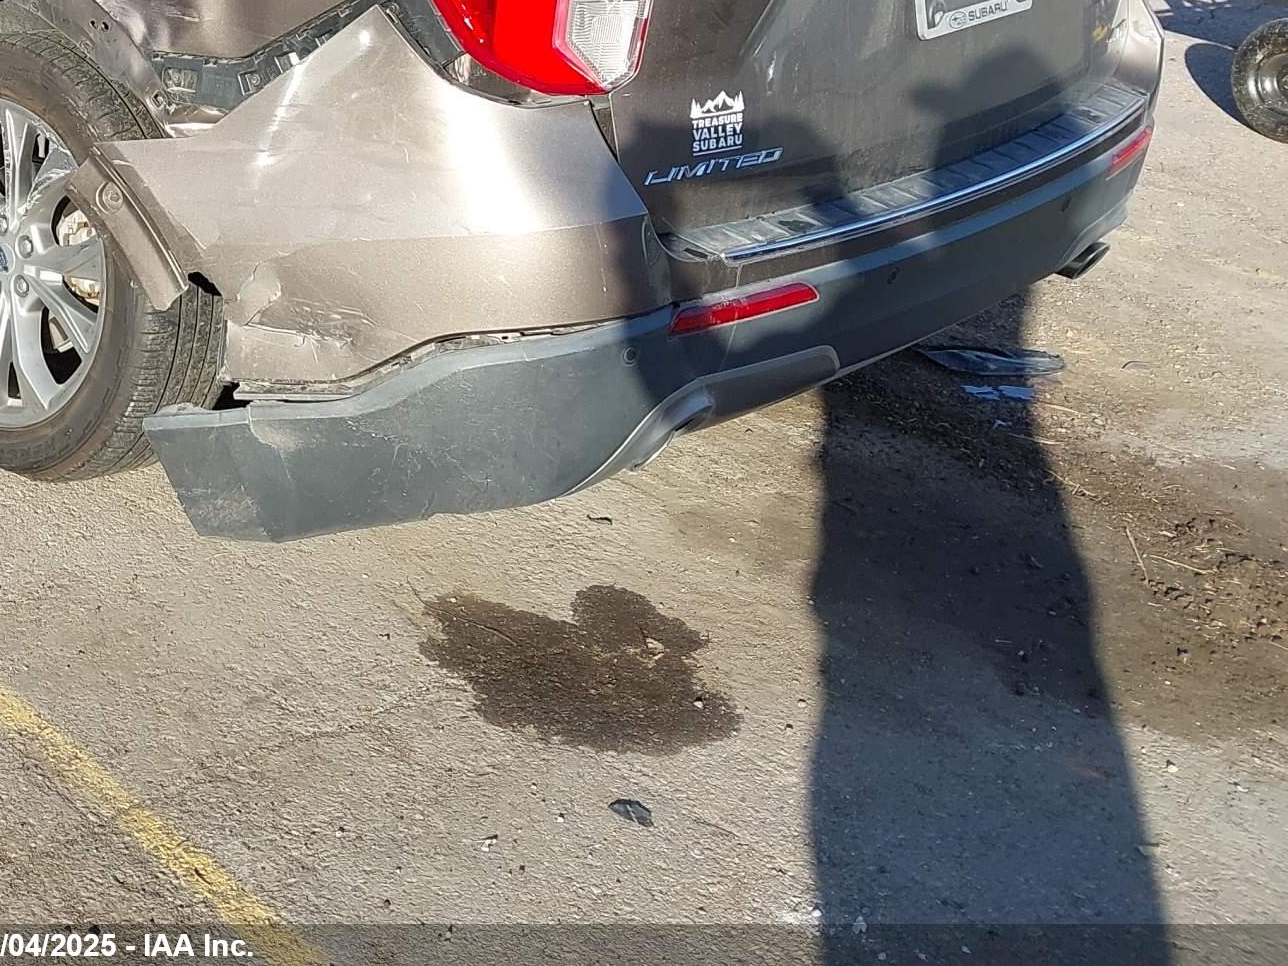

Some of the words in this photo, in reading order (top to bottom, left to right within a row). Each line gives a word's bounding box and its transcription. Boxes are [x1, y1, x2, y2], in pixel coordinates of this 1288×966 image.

[967, 1, 1009, 21] SUBARU
[692, 113, 743, 129] TREASURE
[692, 122, 743, 141] VALLEY
[692, 135, 743, 152] SUBARU
[644, 147, 784, 186] LIMITED
